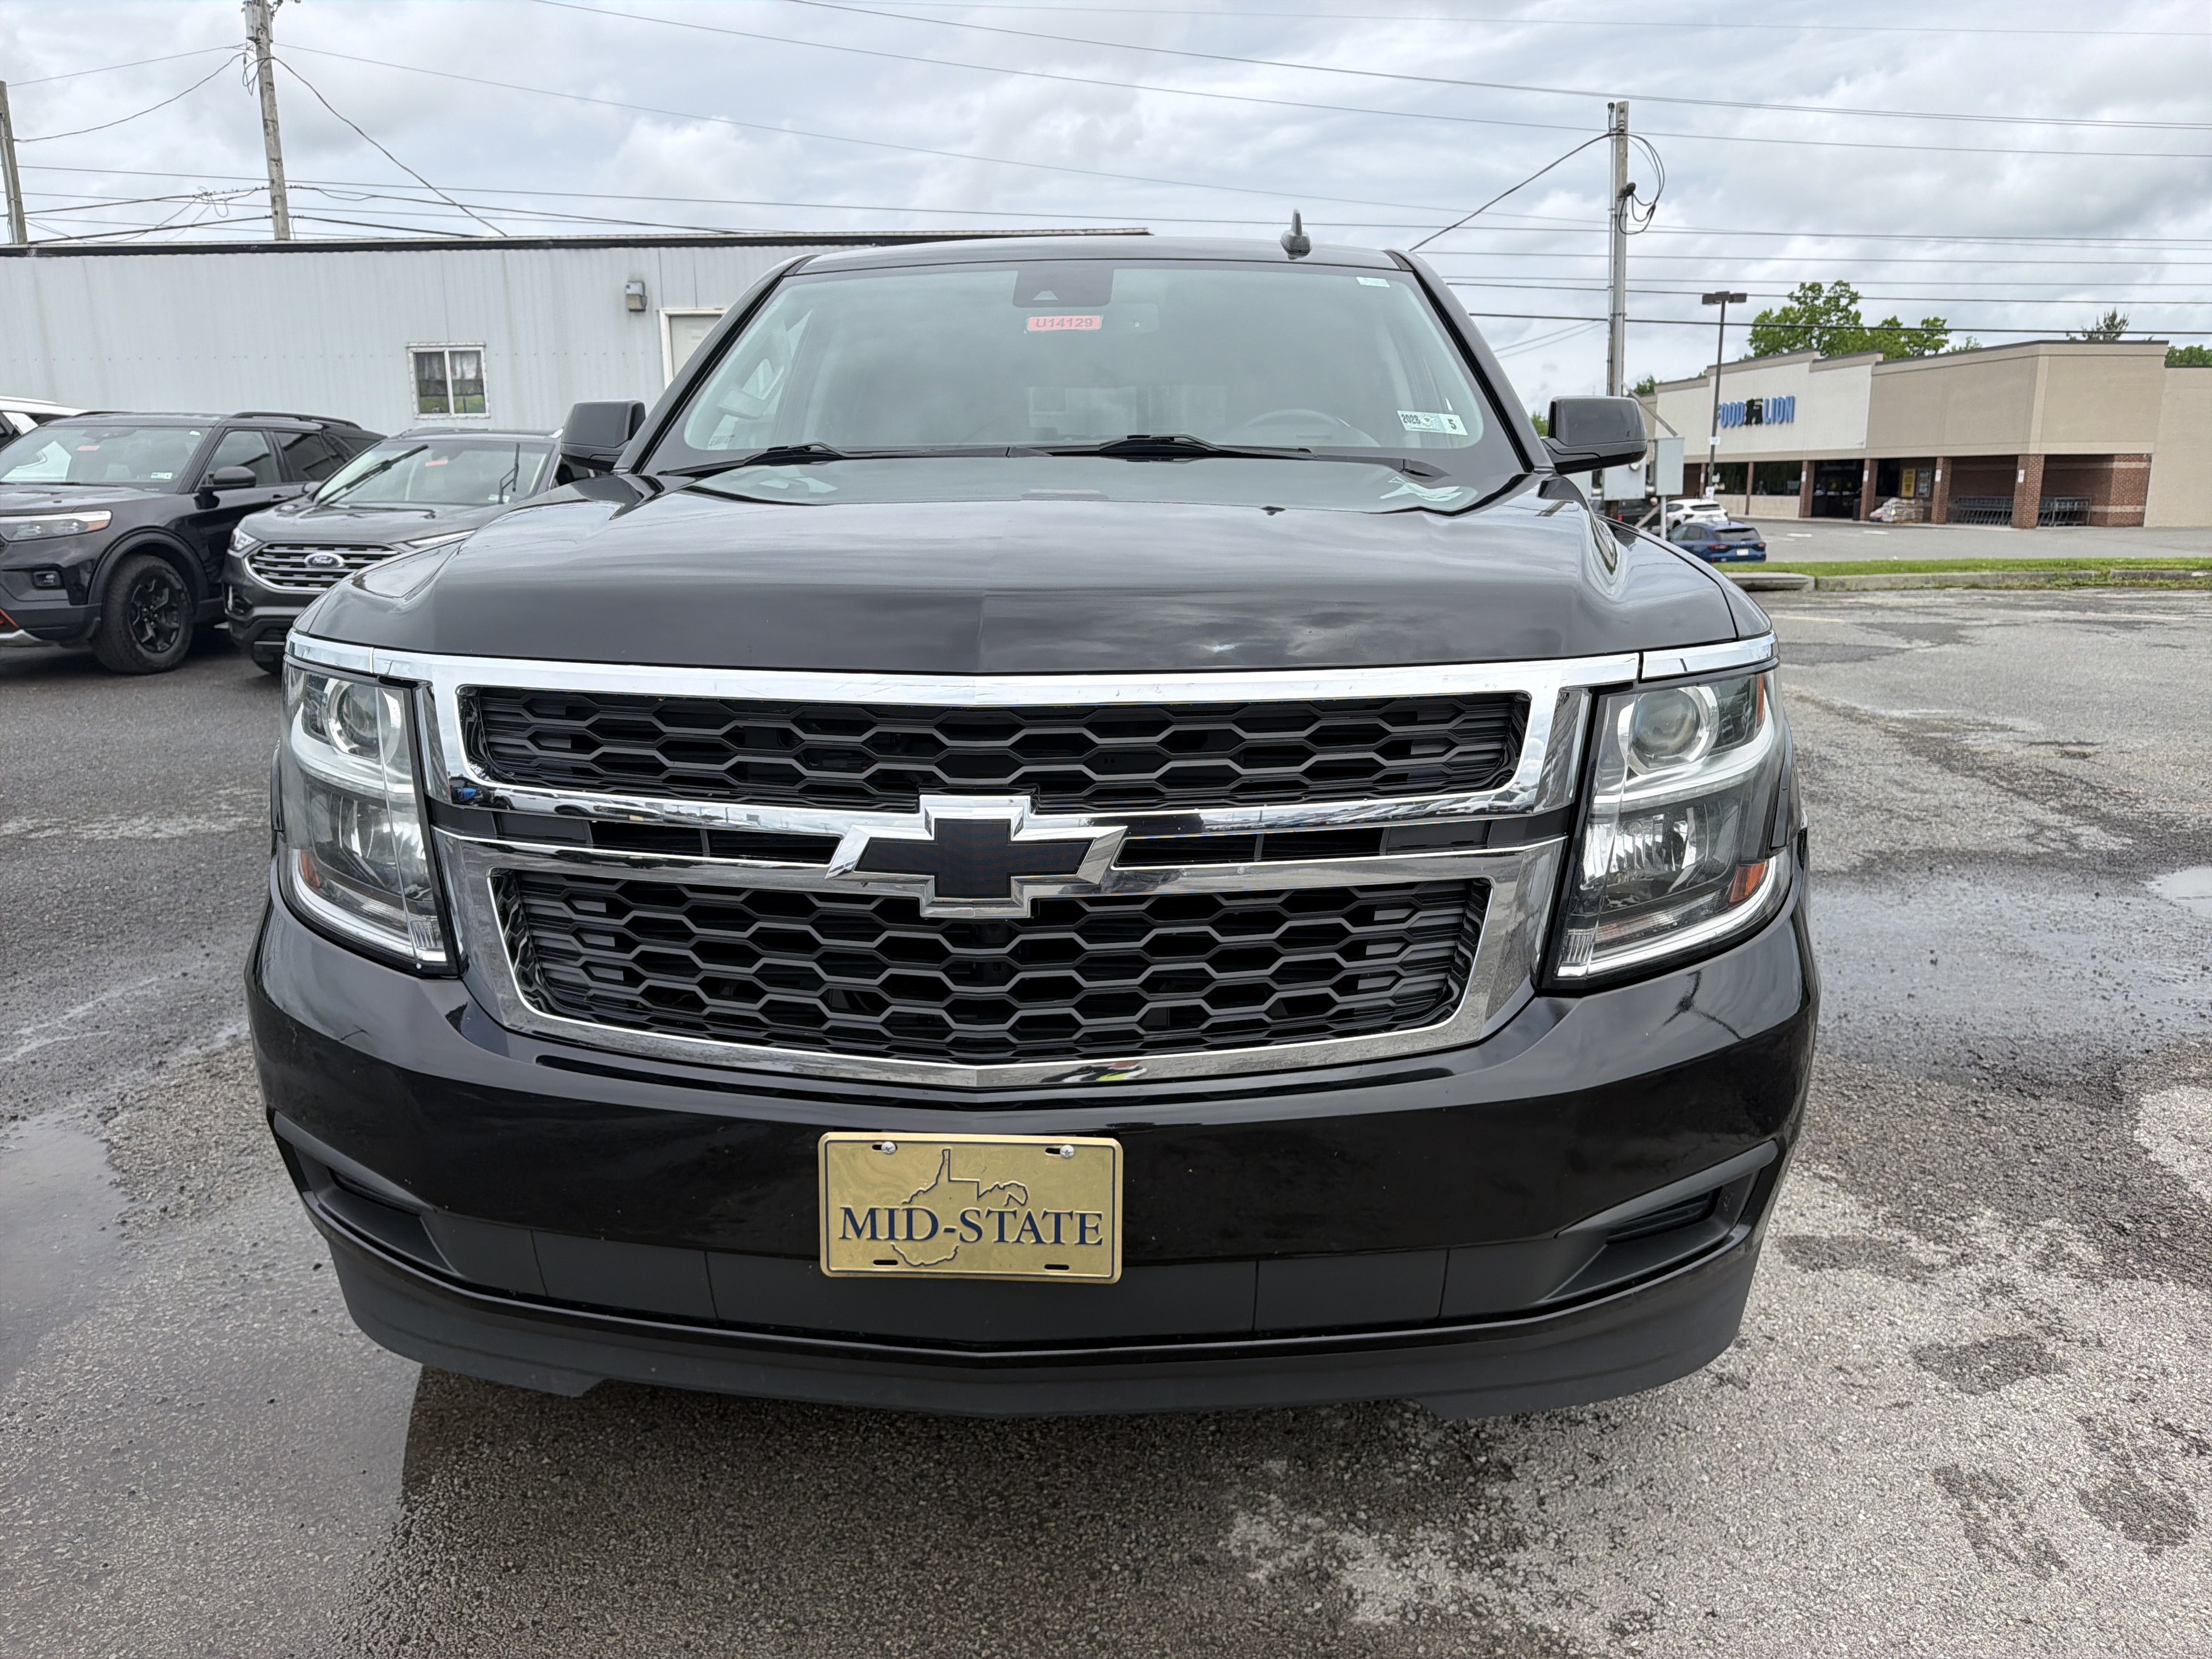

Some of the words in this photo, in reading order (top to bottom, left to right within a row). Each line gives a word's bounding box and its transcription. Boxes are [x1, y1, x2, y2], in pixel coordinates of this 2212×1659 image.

[1035, 318, 1093, 328] U14129
[1763, 394, 1796, 425] LION
[1401, 414, 1421, 424] 2028
[1447, 419, 1457, 430] 5
[838, 1206, 1104, 1246] MID-STATE
